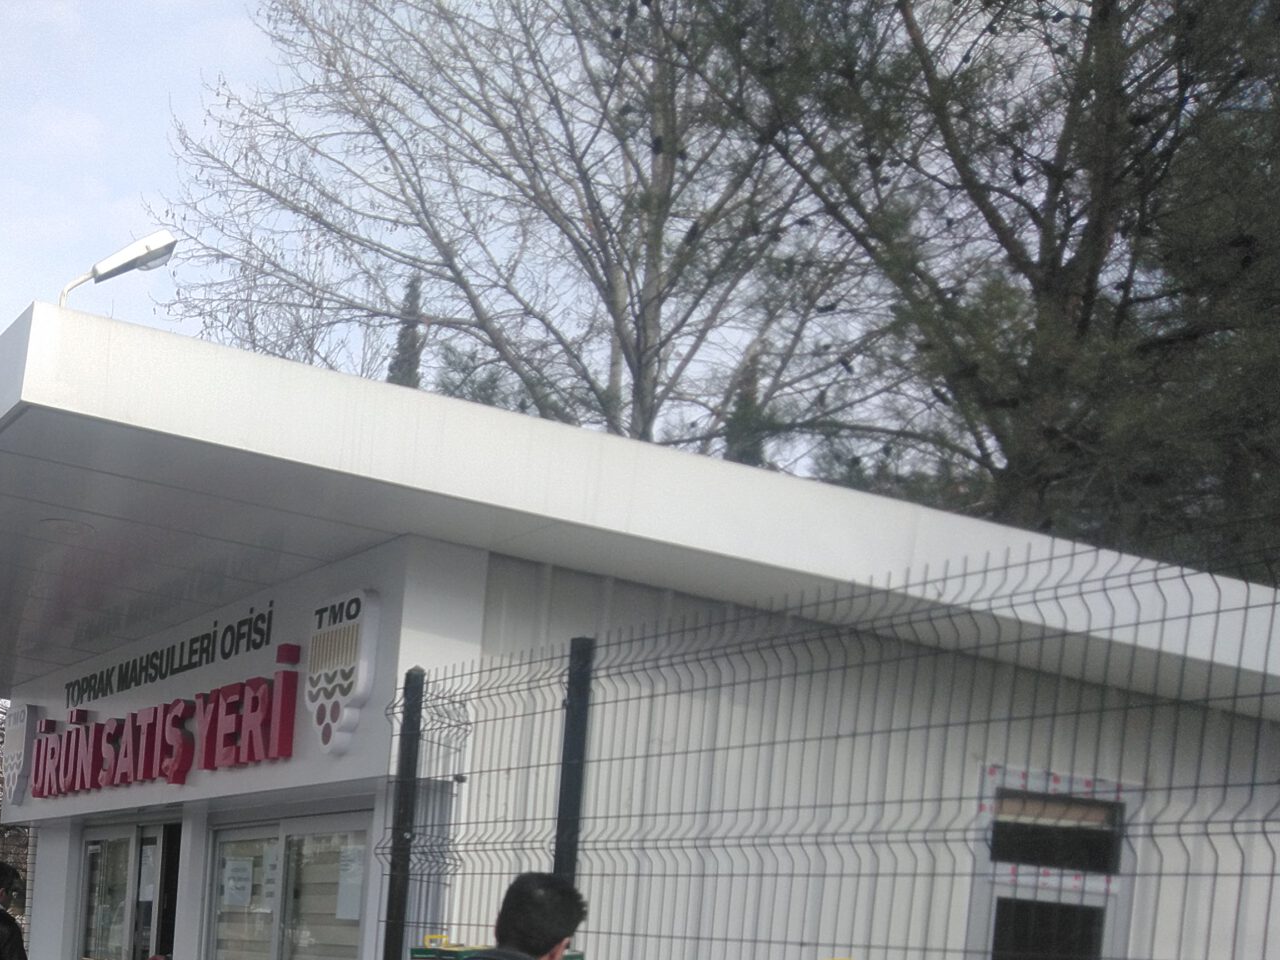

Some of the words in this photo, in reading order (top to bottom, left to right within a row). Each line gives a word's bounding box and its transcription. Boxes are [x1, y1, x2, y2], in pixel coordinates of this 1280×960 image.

[64, 666, 116, 709] TOPRAK
[117, 620, 219, 692] MAHSULLERİ
[220, 600, 274, 661] OFİSİ
[314, 597, 361, 629] TMO
[32, 709, 104, 798] ÜRÜN
[98, 699, 196, 786] SATIŞ
[194, 643, 301, 770] YERİ
